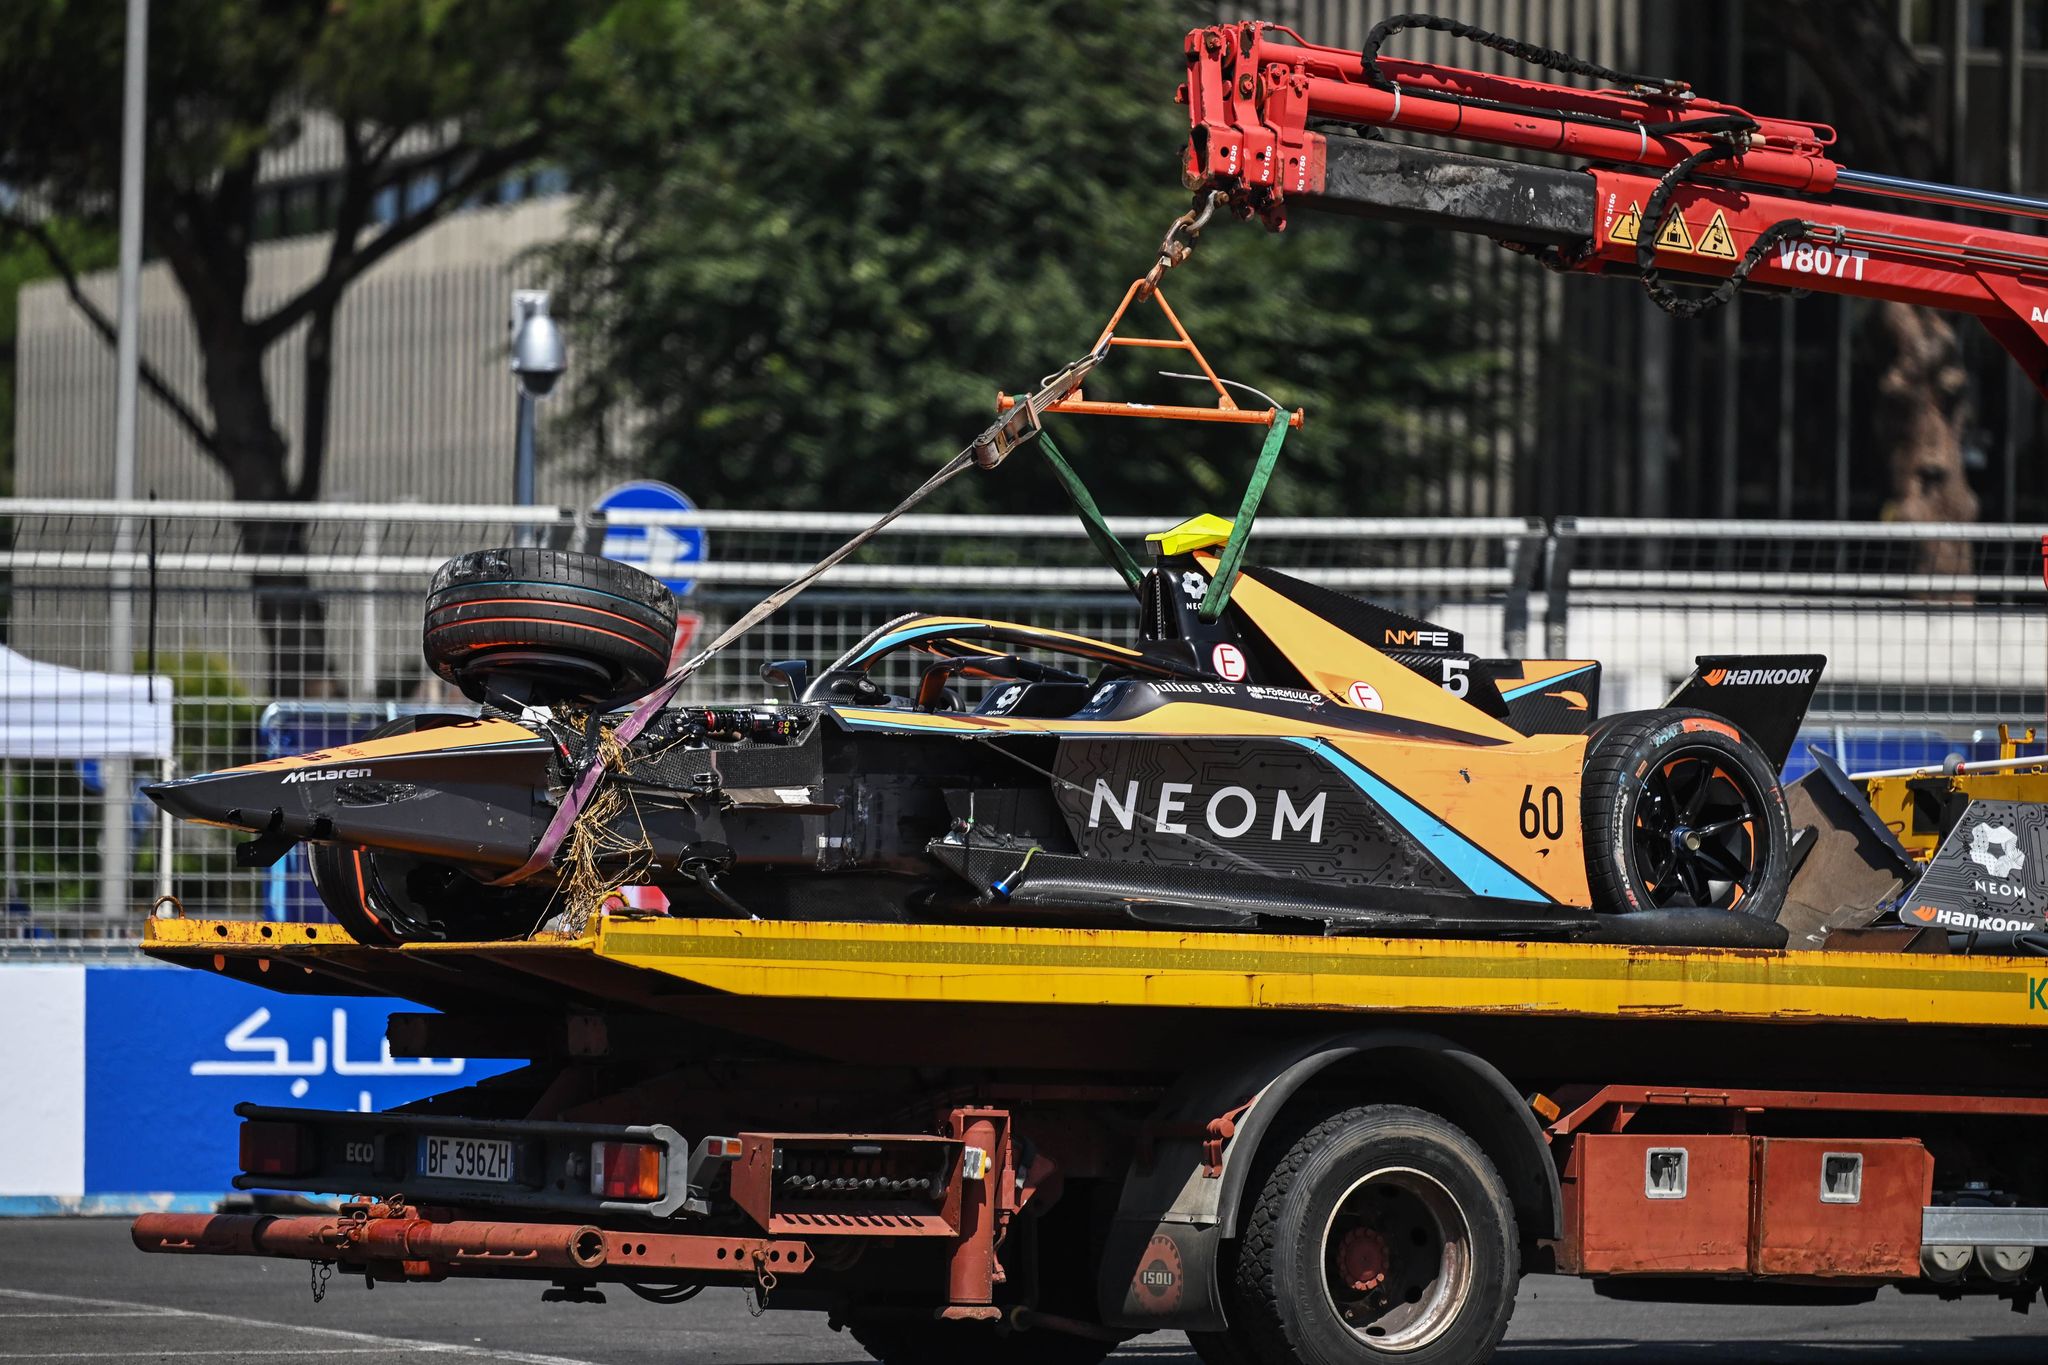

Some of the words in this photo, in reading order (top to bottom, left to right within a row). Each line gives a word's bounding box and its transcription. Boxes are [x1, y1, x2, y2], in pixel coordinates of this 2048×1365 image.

[1264, 145, 1272, 167] 1150
[1261, 169, 1270, 182] Kg
[1297, 179, 1305, 191] Kg
[1604, 216, 1612, 228] Kg
[1779, 240, 1869, 281] V807T
[1385, 629, 1449, 647] NMFE
[1442, 659, 1470, 699] 5
[1147, 682, 1202, 696] Julius
[1202, 682, 1236, 695] Bär
[281, 768, 372, 784] McLaren
[1088, 778, 1327, 843] NEOM
[1519, 784, 1563, 840] 60
[1974, 881, 2026, 899] NEOM
[346, 1142, 374, 1163] ECO
[428, 1139, 449, 1174] BF
[455, 1141, 508, 1178] 396ZH
[1143, 1271, 1172, 1286] ISOLI
